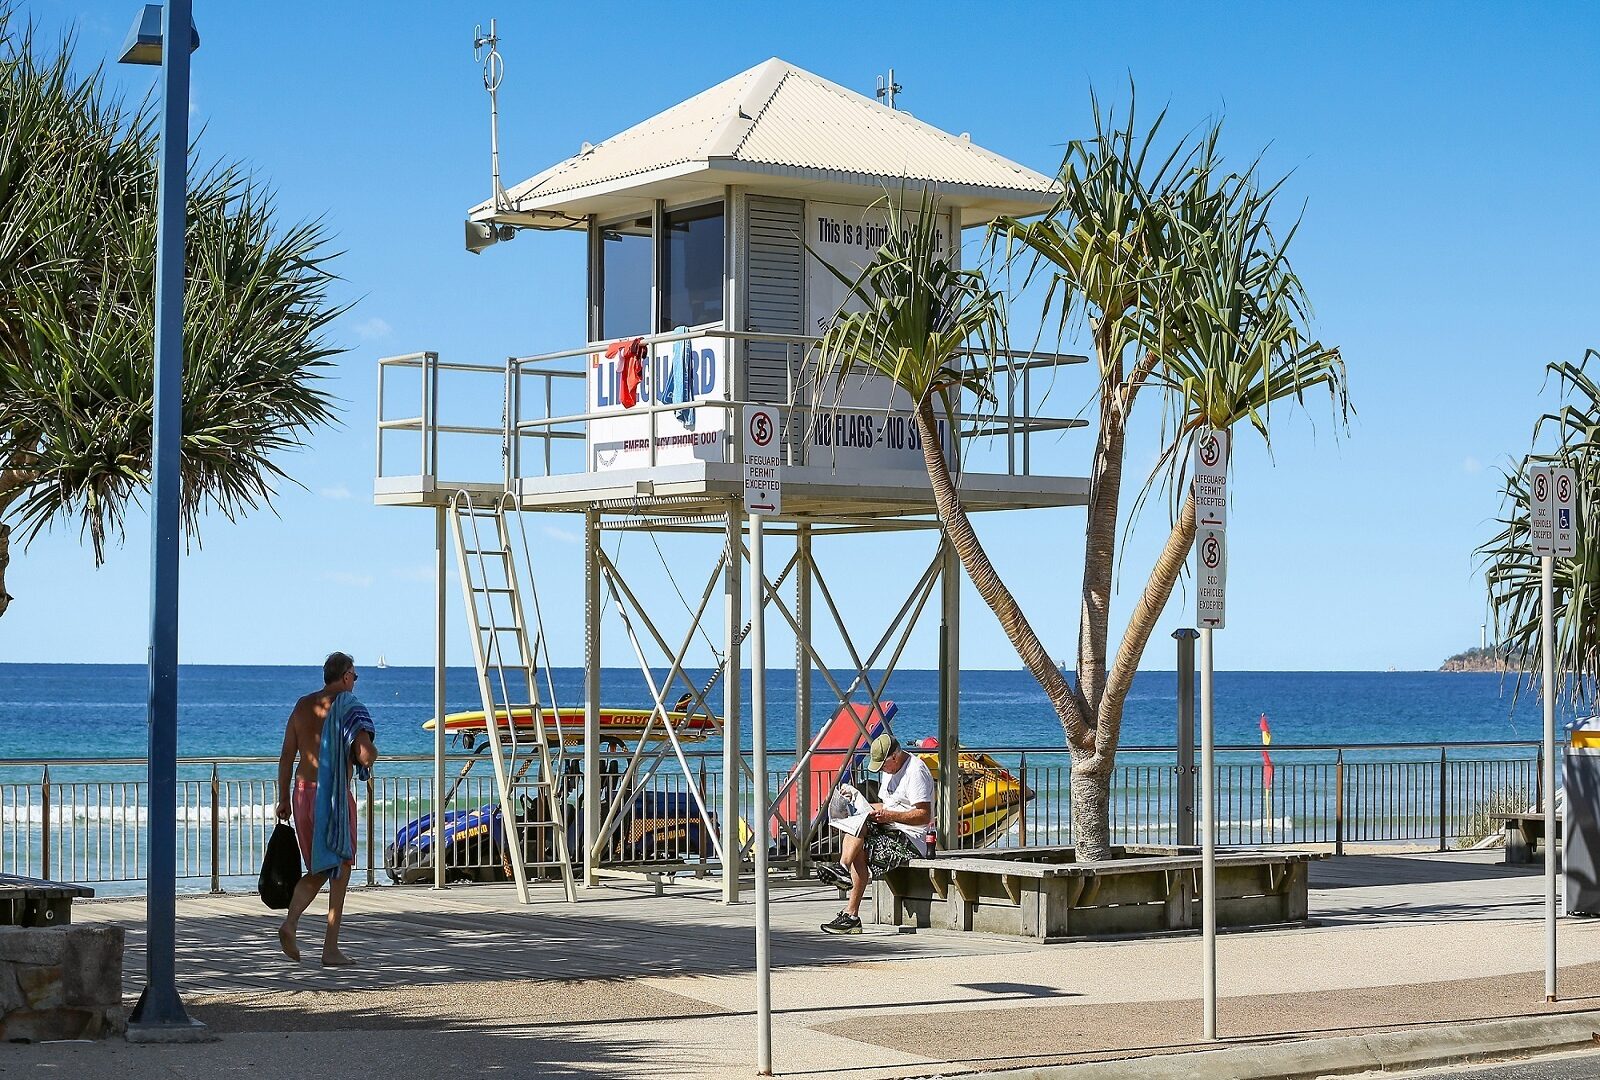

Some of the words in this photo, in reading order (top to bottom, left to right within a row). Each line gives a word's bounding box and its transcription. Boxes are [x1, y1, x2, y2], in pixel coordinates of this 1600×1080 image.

[818, 217, 841, 244] This
[843, 220, 853, 245] is
[856, 224, 862, 246] a
[597, 348, 716, 407] LIGURD
[814, 413, 832, 447] NO
[835, 414, 874, 449] FLAGS
[887, 416, 905, 450] NO
[744, 455, 780, 467] LIFEGUARD
[750, 467, 775, 478] PERMIT
[745, 479, 780, 491] EXCEPTED
[1195, 474, 1227, 485] LIFEGUARD
[1200, 486, 1222, 496] PERMIT
[1196, 496, 1226, 507] EXCEPTED
[1199, 587, 1224, 598] VEHICLES
[1199, 600, 1224, 610] EXCEPTED
